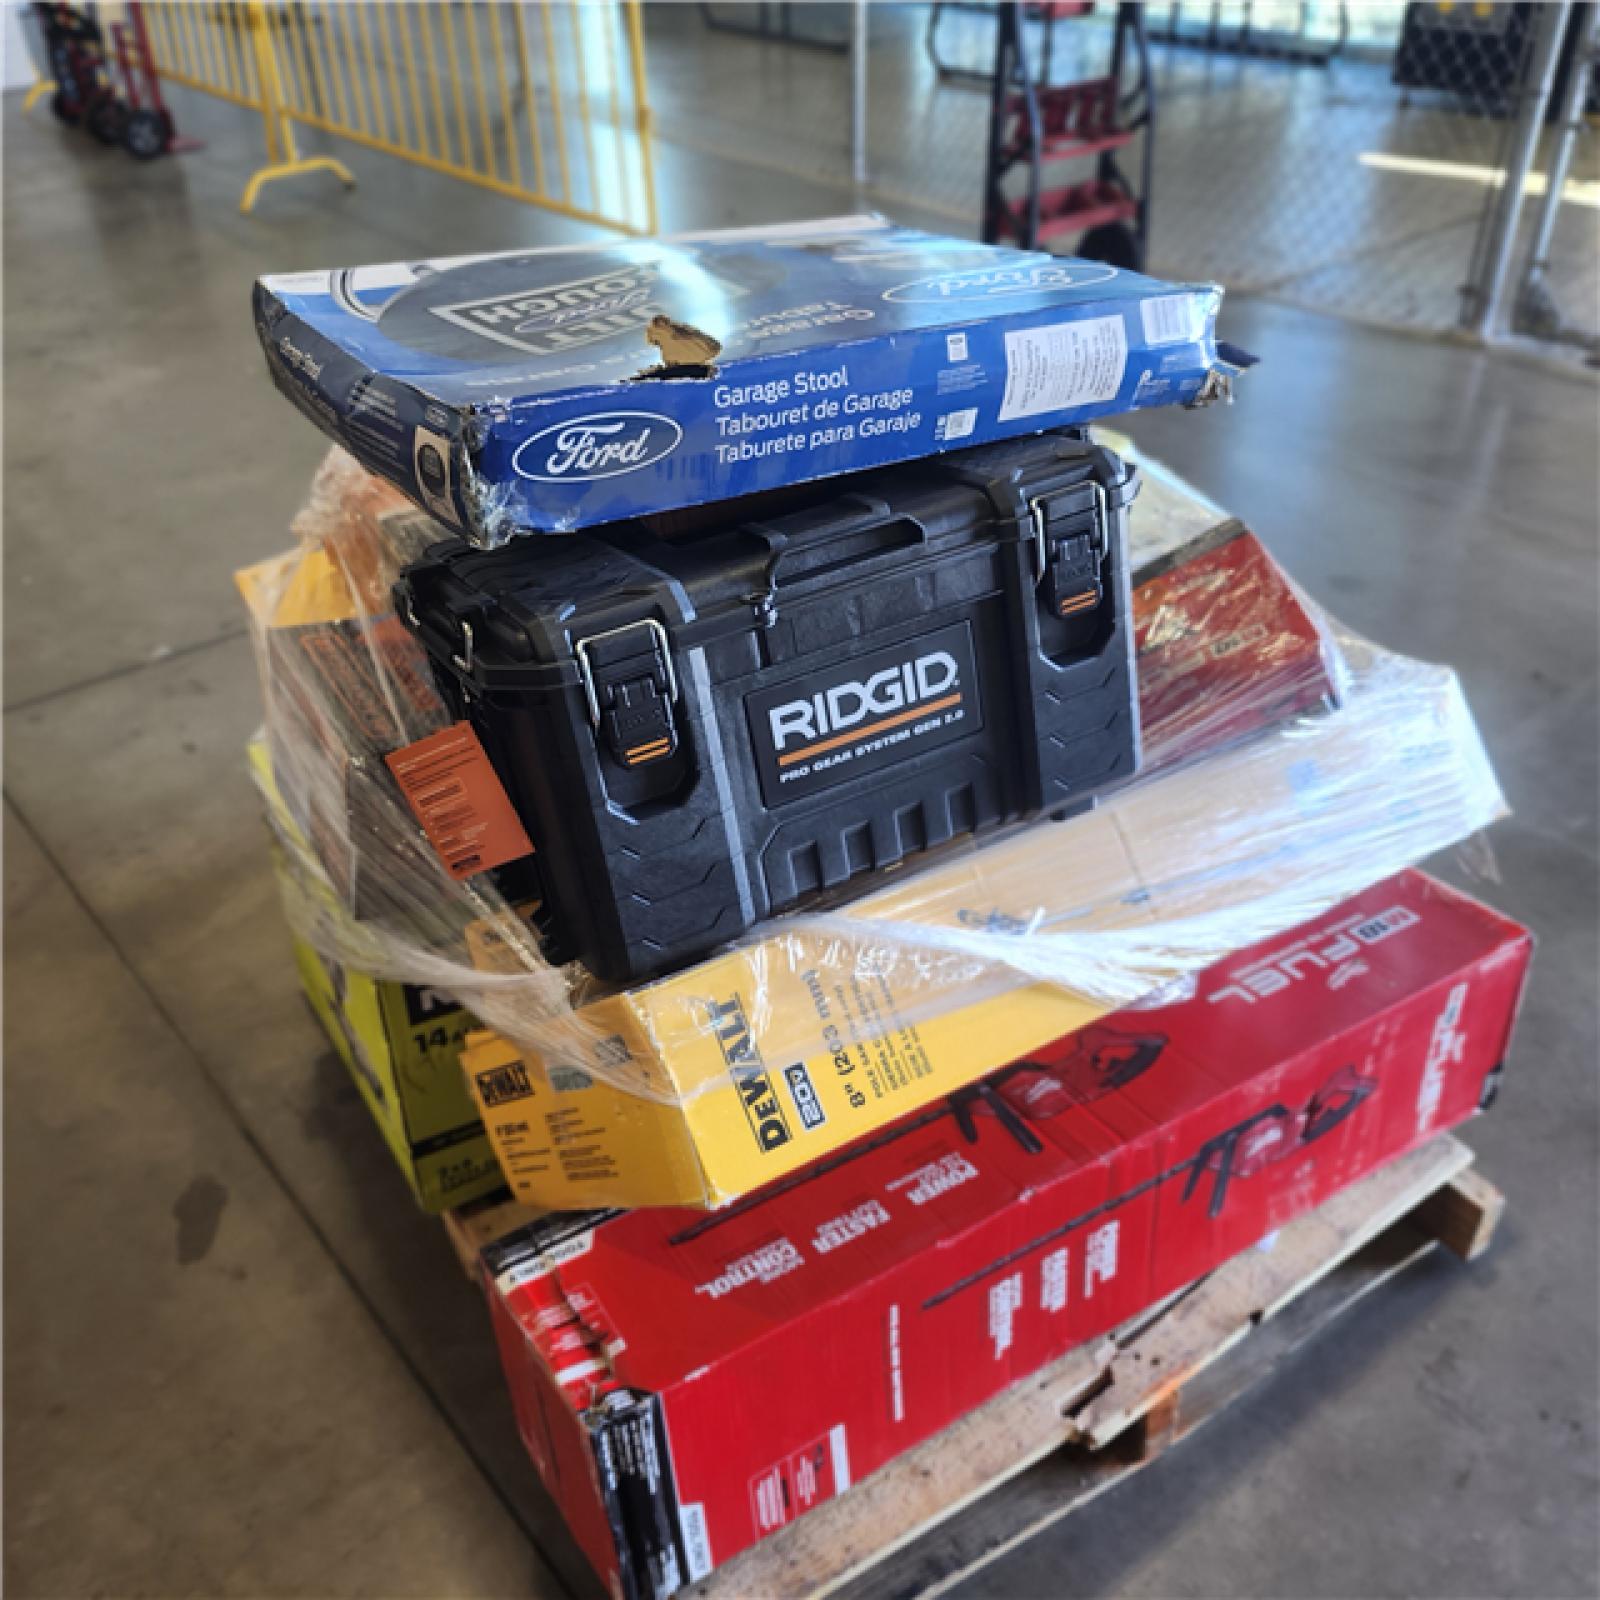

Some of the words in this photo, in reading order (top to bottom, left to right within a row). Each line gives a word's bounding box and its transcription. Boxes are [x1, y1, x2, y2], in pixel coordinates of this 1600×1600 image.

[714, 379, 790, 408] Garage
[794, 365, 849, 394] Stool
[715, 404, 809, 435] Tabouret
[814, 399, 839, 420] de
[844, 387, 913, 413] Garage
[547, 421, 651, 473] Ford
[715, 433, 806, 463] Taburete
[810, 424, 856, 450] para
[859, 412, 921, 438] Garaje
[768, 651, 957, 750] RIDGID
[779, 765, 811, 784] PRO
[812, 750, 852, 771] GEAR
[854, 729, 911, 757] SYSTEM
[913, 716, 942, 736] GEN
[1207, 933, 1361, 1004] FUEL
[704, 994, 790, 1152] DEWALT
[845, 1083, 866, 1108] 8"
[906, 1160, 979, 1206] POWER
[812, 1207, 890, 1253] FASTER
[702, 1244, 797, 1299] CONTROL
